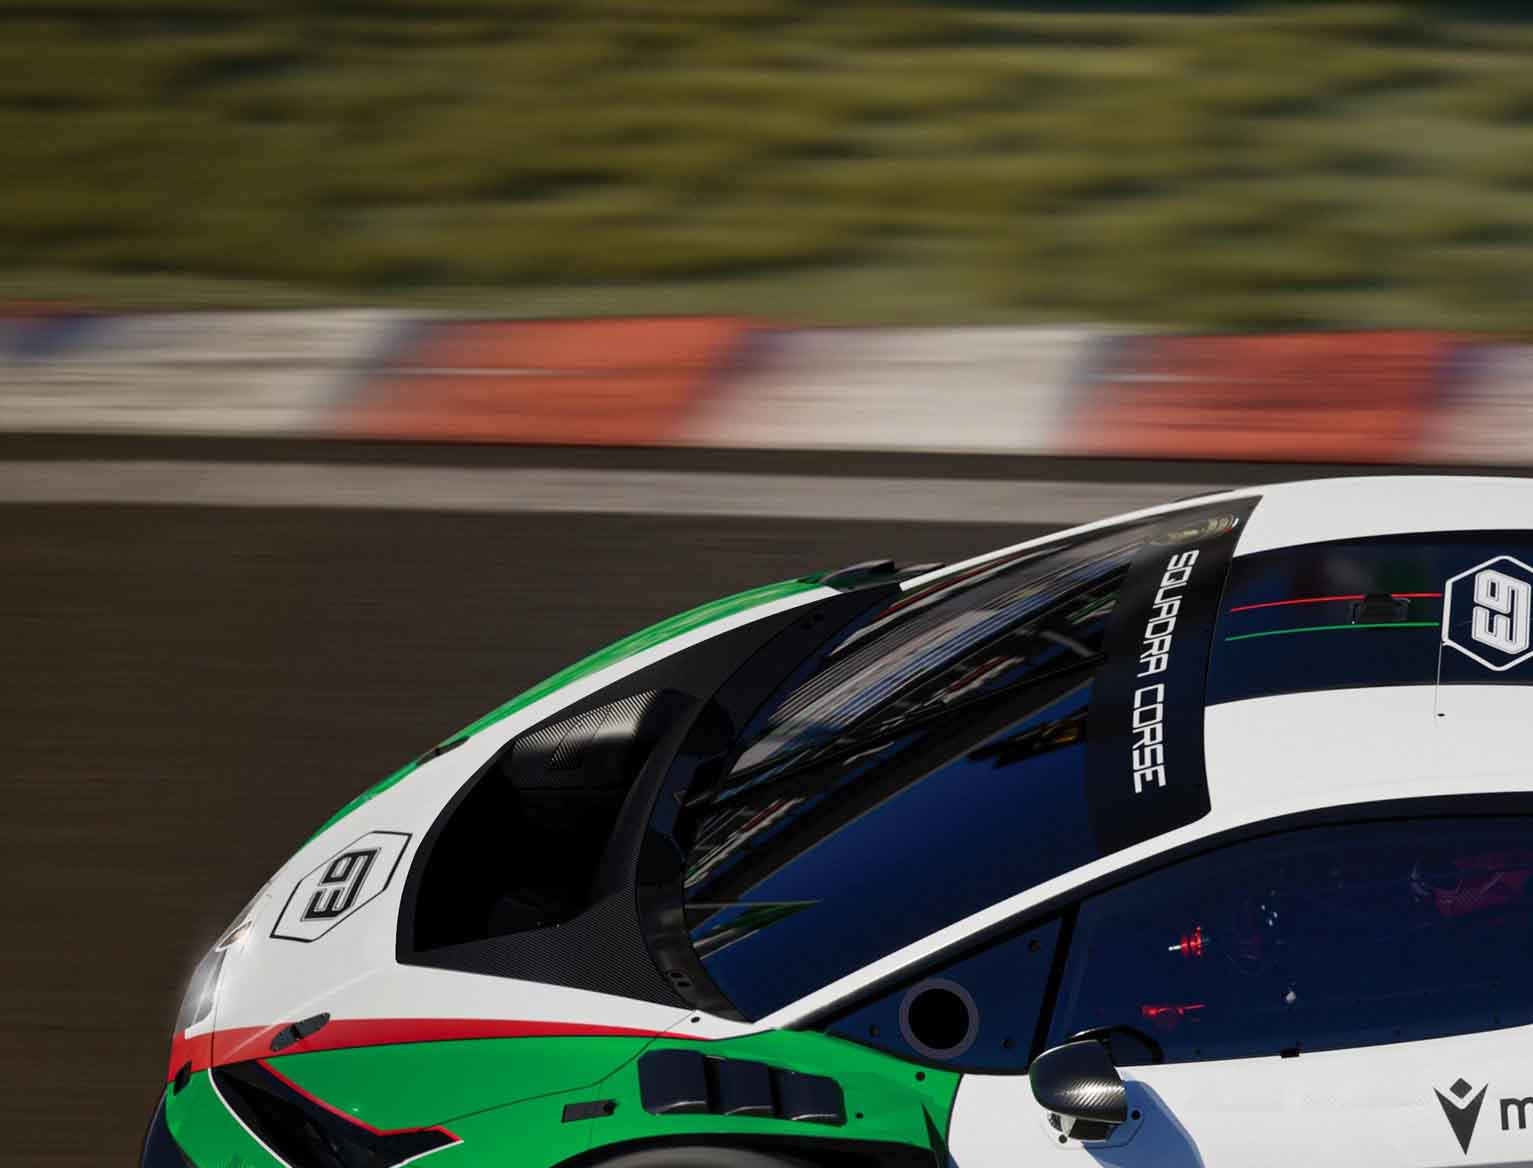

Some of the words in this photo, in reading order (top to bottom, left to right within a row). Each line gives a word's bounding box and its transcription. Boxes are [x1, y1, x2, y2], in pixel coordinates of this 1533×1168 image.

[1137, 549, 1200, 678] SQUADRA
[1472, 569, 1532, 655] 63
[1132, 684, 1167, 793] CORSE
[300, 846, 382, 922] 63
